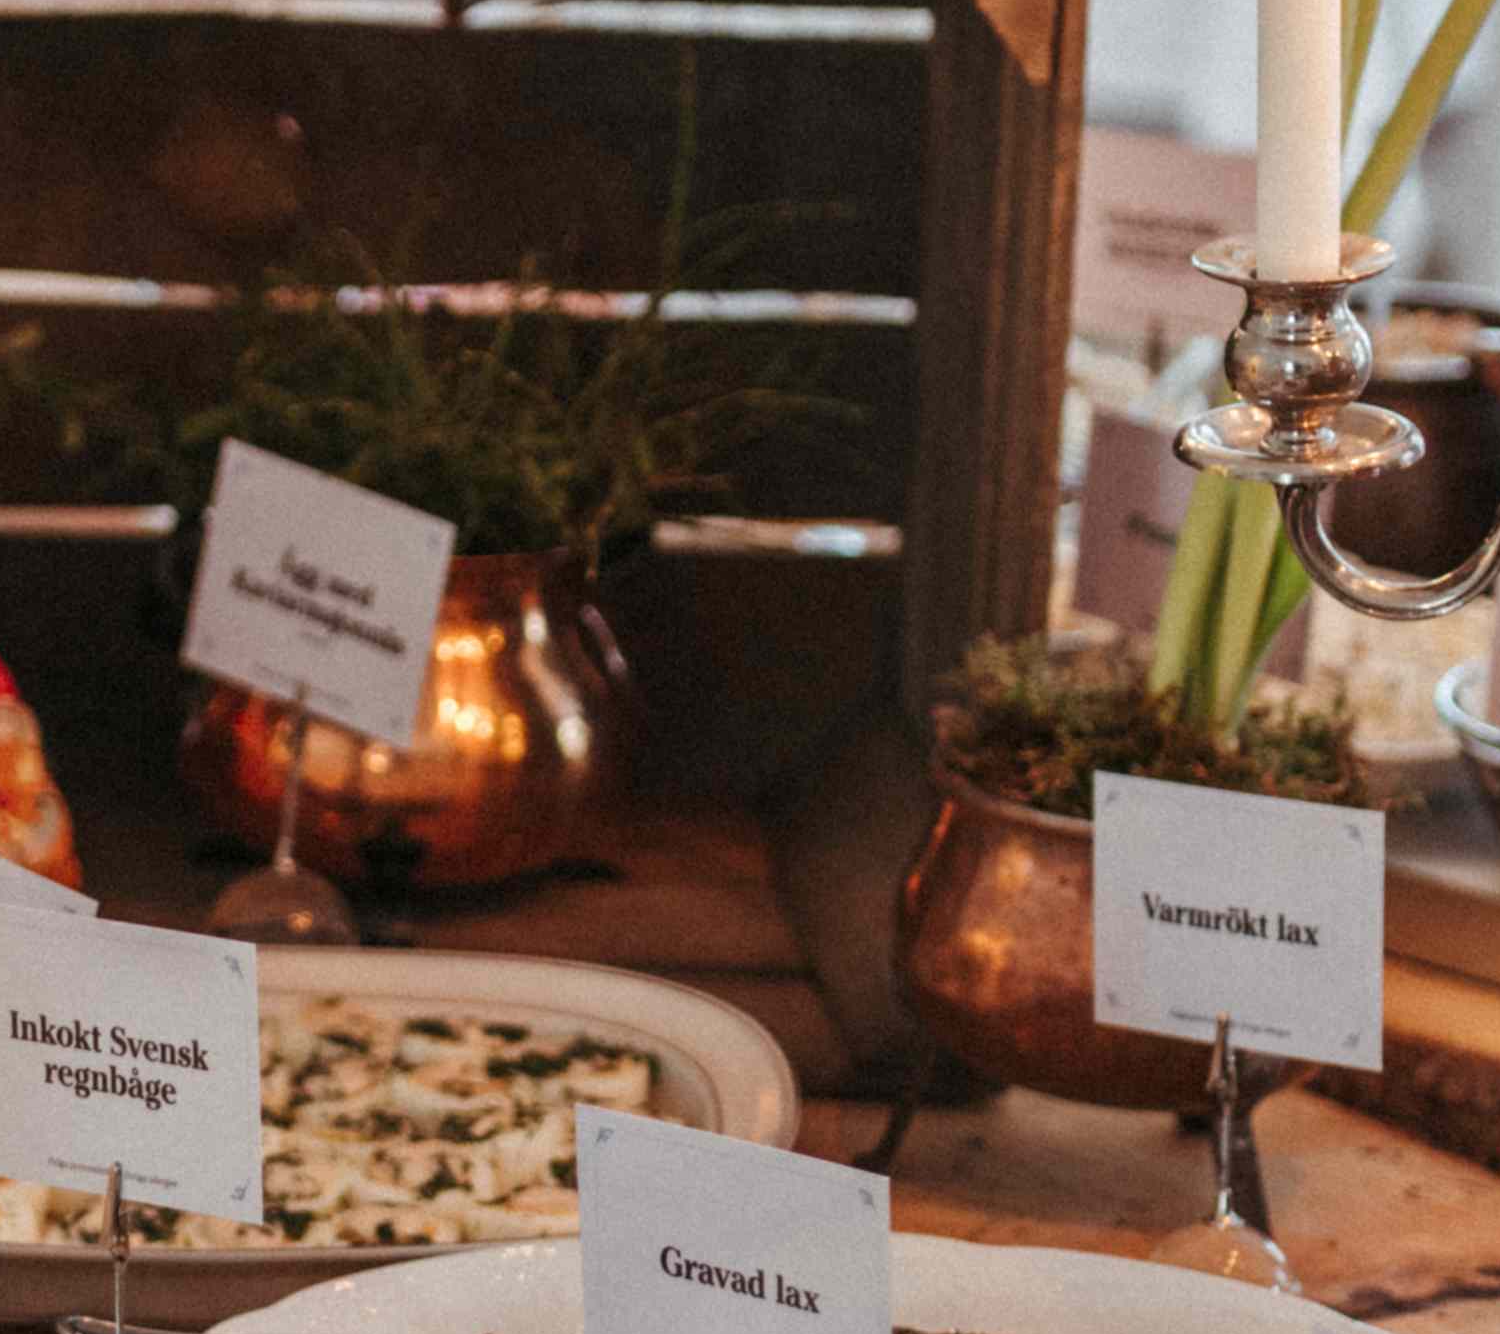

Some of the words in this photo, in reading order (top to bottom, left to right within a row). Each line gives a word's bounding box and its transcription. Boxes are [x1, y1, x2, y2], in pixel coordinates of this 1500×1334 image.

[1141, 890, 1269, 940] Varmrökt
[1277, 913, 1320, 947] lax
[9, 1009, 102, 1053] Inkokt
[109, 1026, 209, 1071] Svensk
[43, 1058, 177, 1111] regnbåge
[659, 1244, 767, 1301] Gravad
[775, 1274, 821, 1315] lax
